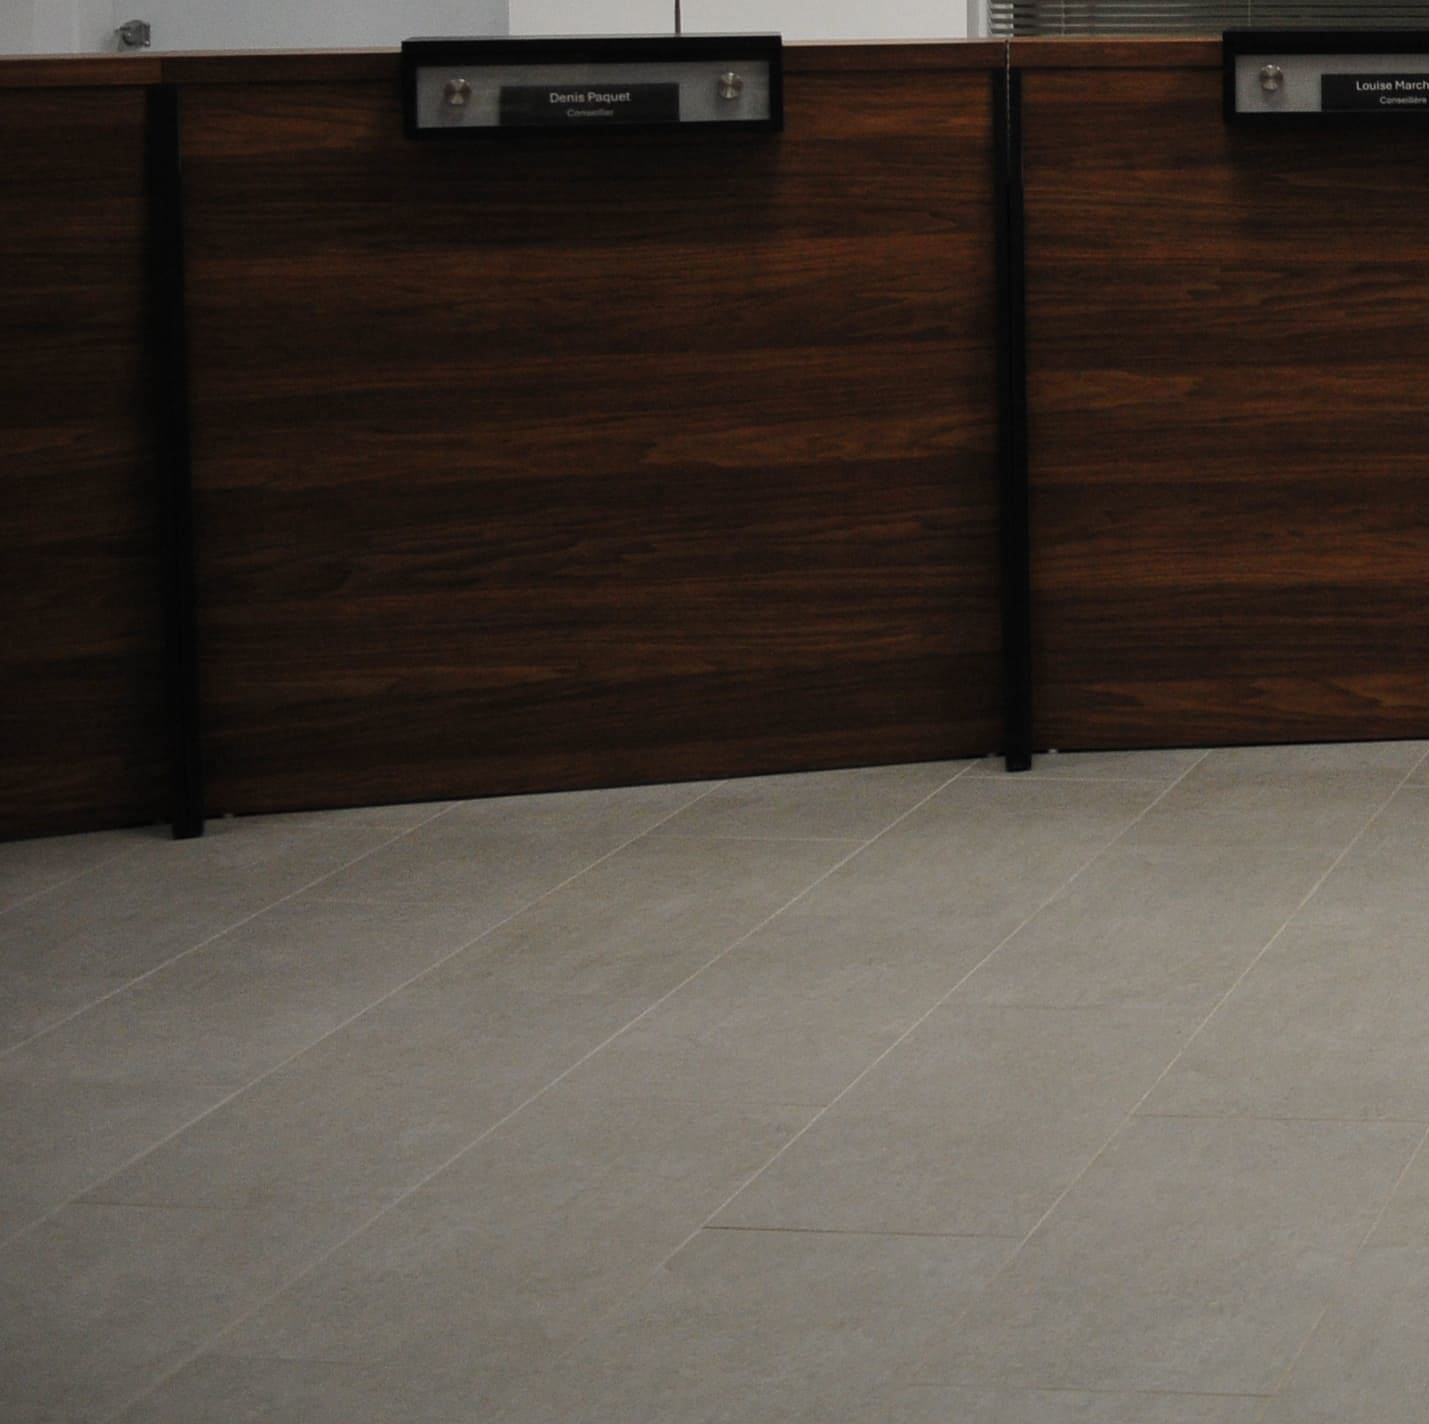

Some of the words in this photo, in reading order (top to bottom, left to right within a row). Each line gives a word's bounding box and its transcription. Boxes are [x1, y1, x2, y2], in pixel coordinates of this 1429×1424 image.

[1355, 80, 1393, 91] Louise
[548, 92, 585, 104] Denis
[586, 90, 631, 105] Paquet
